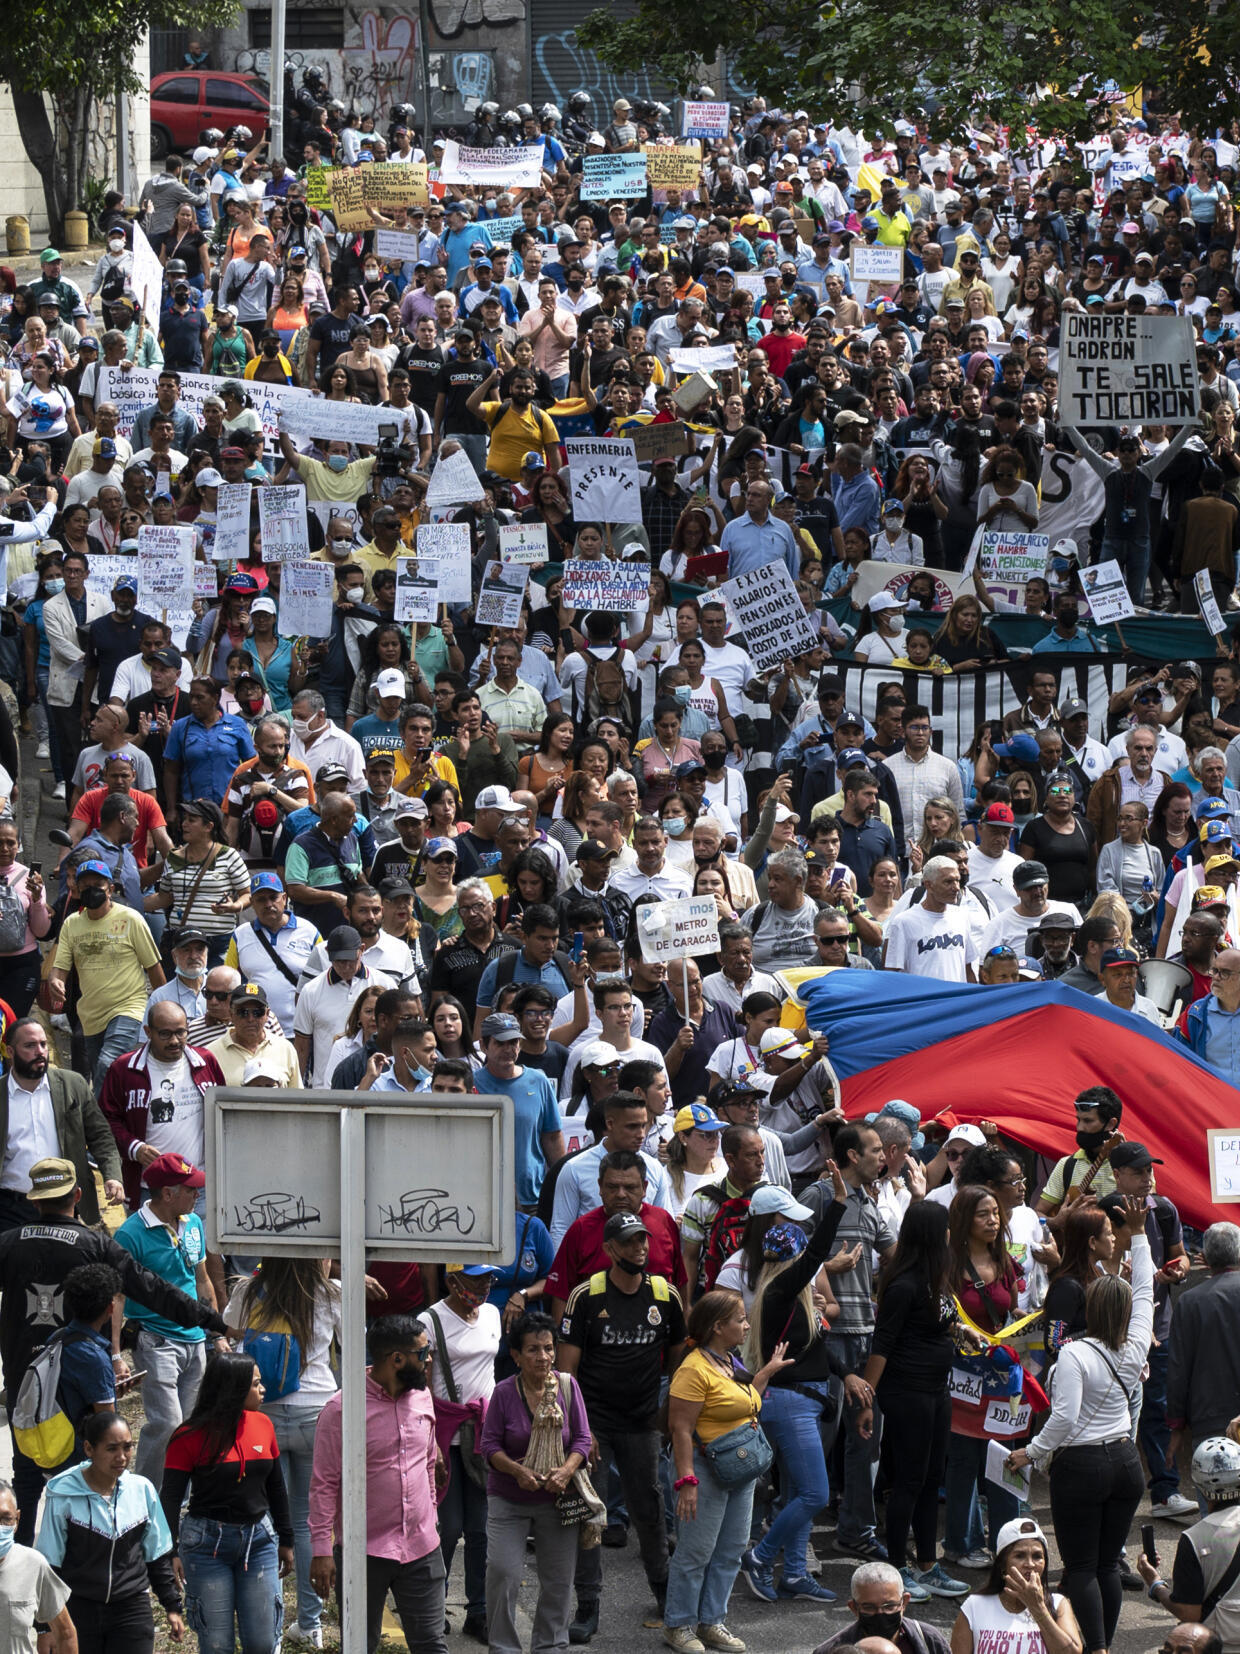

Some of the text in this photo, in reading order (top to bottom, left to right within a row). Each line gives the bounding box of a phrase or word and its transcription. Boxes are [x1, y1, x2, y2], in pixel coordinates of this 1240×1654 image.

[1068, 338, 1135, 360] LADRÓN
[408, 360, 441, 369] CREEMOS
[108, 372, 149, 386] Salarios
[450, 374, 483, 382] CREEMOS
[1077, 366, 1110, 390] TE
[110, 388, 145, 400] básica
[567, 443, 633, 457] ENFERMERIA
[575, 465, 634, 500] PRESENTE
[984, 532, 999, 546] NO
[1013, 533, 1049, 547] SALARIO
[983, 545, 1028, 555] DE HAMBRE
[291, 562, 329, 571] VENEZUELA
[567, 561, 611, 571] PENSIONES
[618, 562, 651, 573] SALARIOS
[991, 557, 998, 569] A
[998, 556, 1047, 569] PENSIONES
[565, 571, 642, 582] INDEXADOS A LA
[736, 565, 774, 589] EXIGE
[996, 570, 1029, 581] MUERTE
[565, 581, 598, 590] CANASTA
[564, 590, 647, 600] NO A LA ESCLAVITUD
[733, 578, 787, 610] SALARIOS Y
[574, 600, 637, 610] POR HAMBRE
[740, 592, 796, 625] PENSIONES
[745, 609, 806, 642] INDEXADOS AL
[752, 623, 810, 654] COSTO DE LA
[757, 648, 791, 671] CANASTA
[690, 904, 714, 915] mos
[675, 918, 708, 931] METRO
[656, 934, 718, 951] DE CARACAS
[601, 1324, 656, 1344] bwin
[948, 1370, 981, 1398] bertad
[980, 1630, 1041, 1640] YOU DON'T KN
[977, 1640, 1010, 1654] WHO
